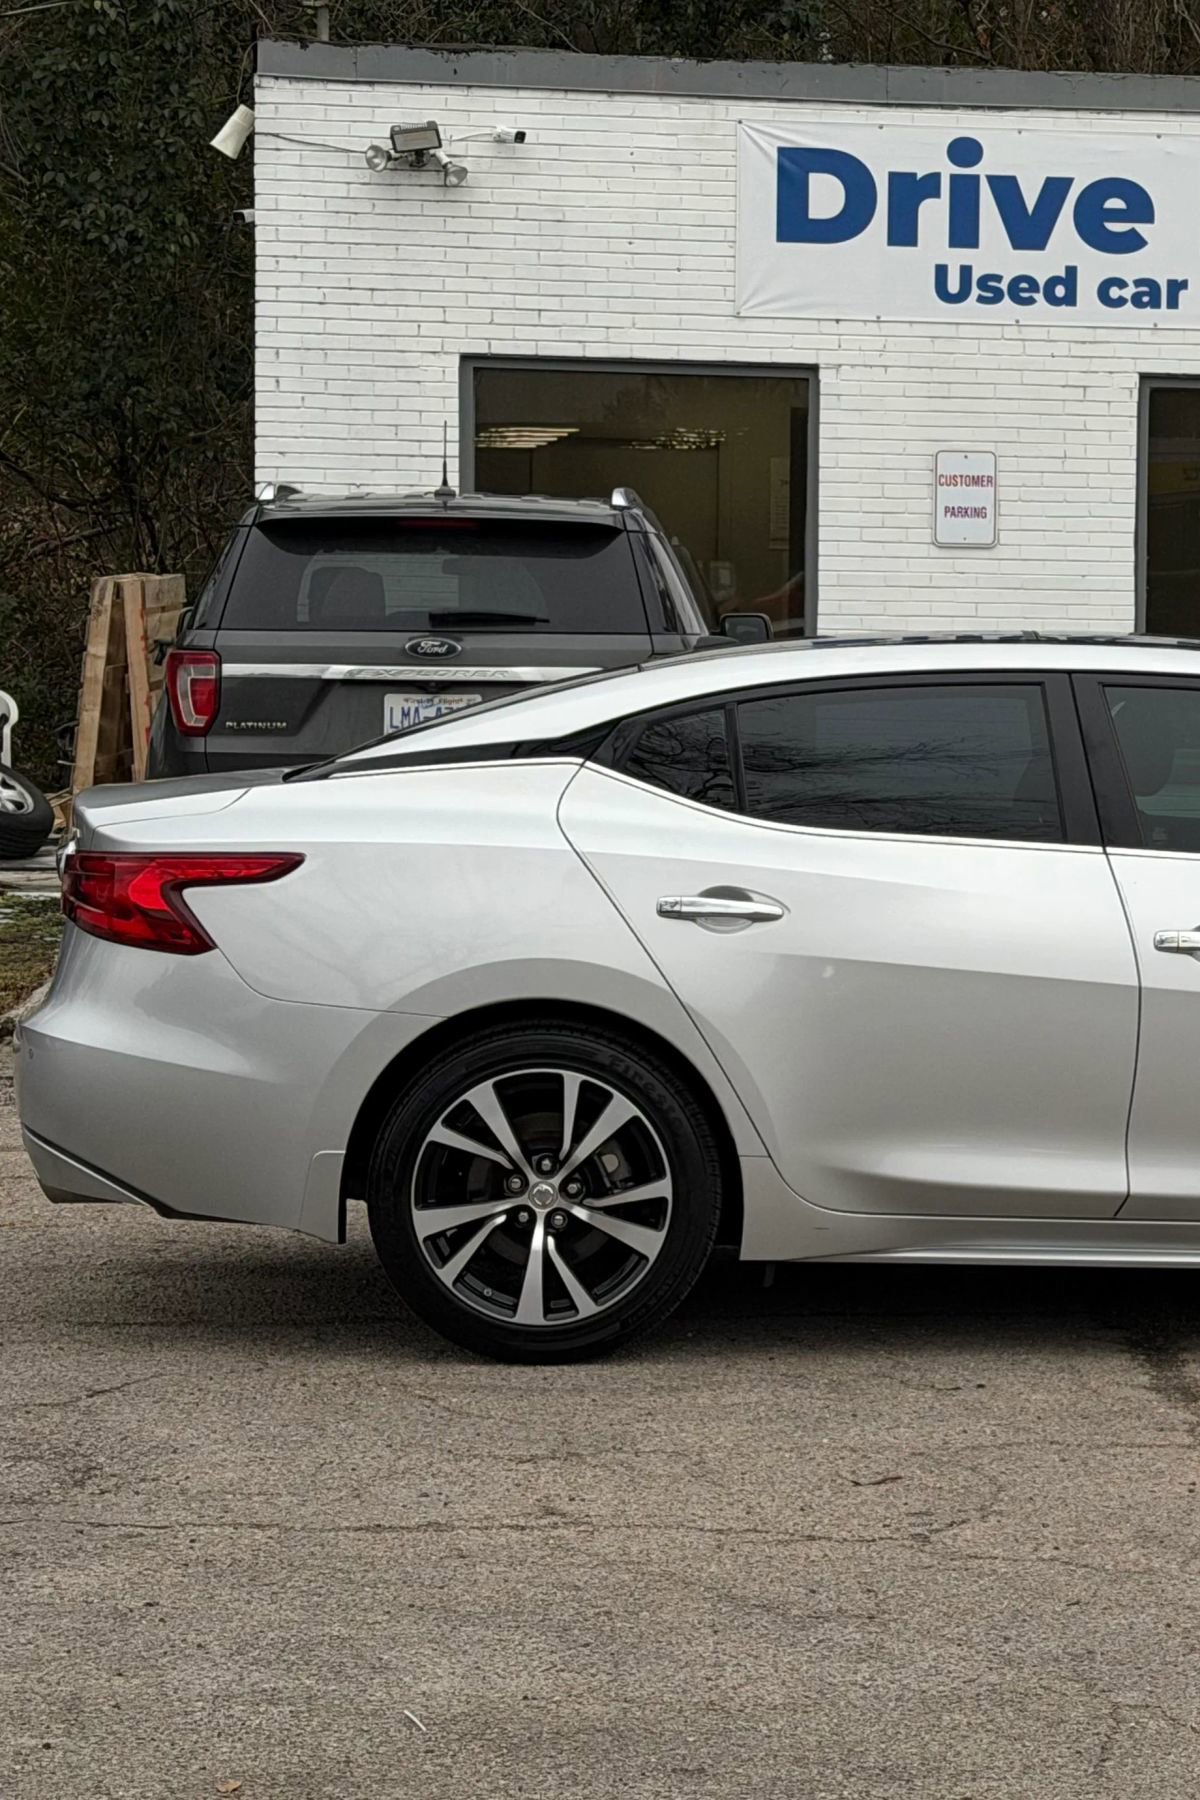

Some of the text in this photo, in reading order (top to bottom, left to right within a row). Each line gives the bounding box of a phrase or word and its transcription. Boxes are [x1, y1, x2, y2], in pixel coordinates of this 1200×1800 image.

[777, 137, 1154, 254] Drive
[935, 264, 1078, 307] Used
[1097, 276, 1188, 310] car
[938, 474, 993, 487] CUSTOMER
[944, 506, 987, 519] PARKING
[417, 640, 448, 653] Ford
[356, 668, 509, 678] EXPLORER
[225, 721, 287, 729] PLATINUM
